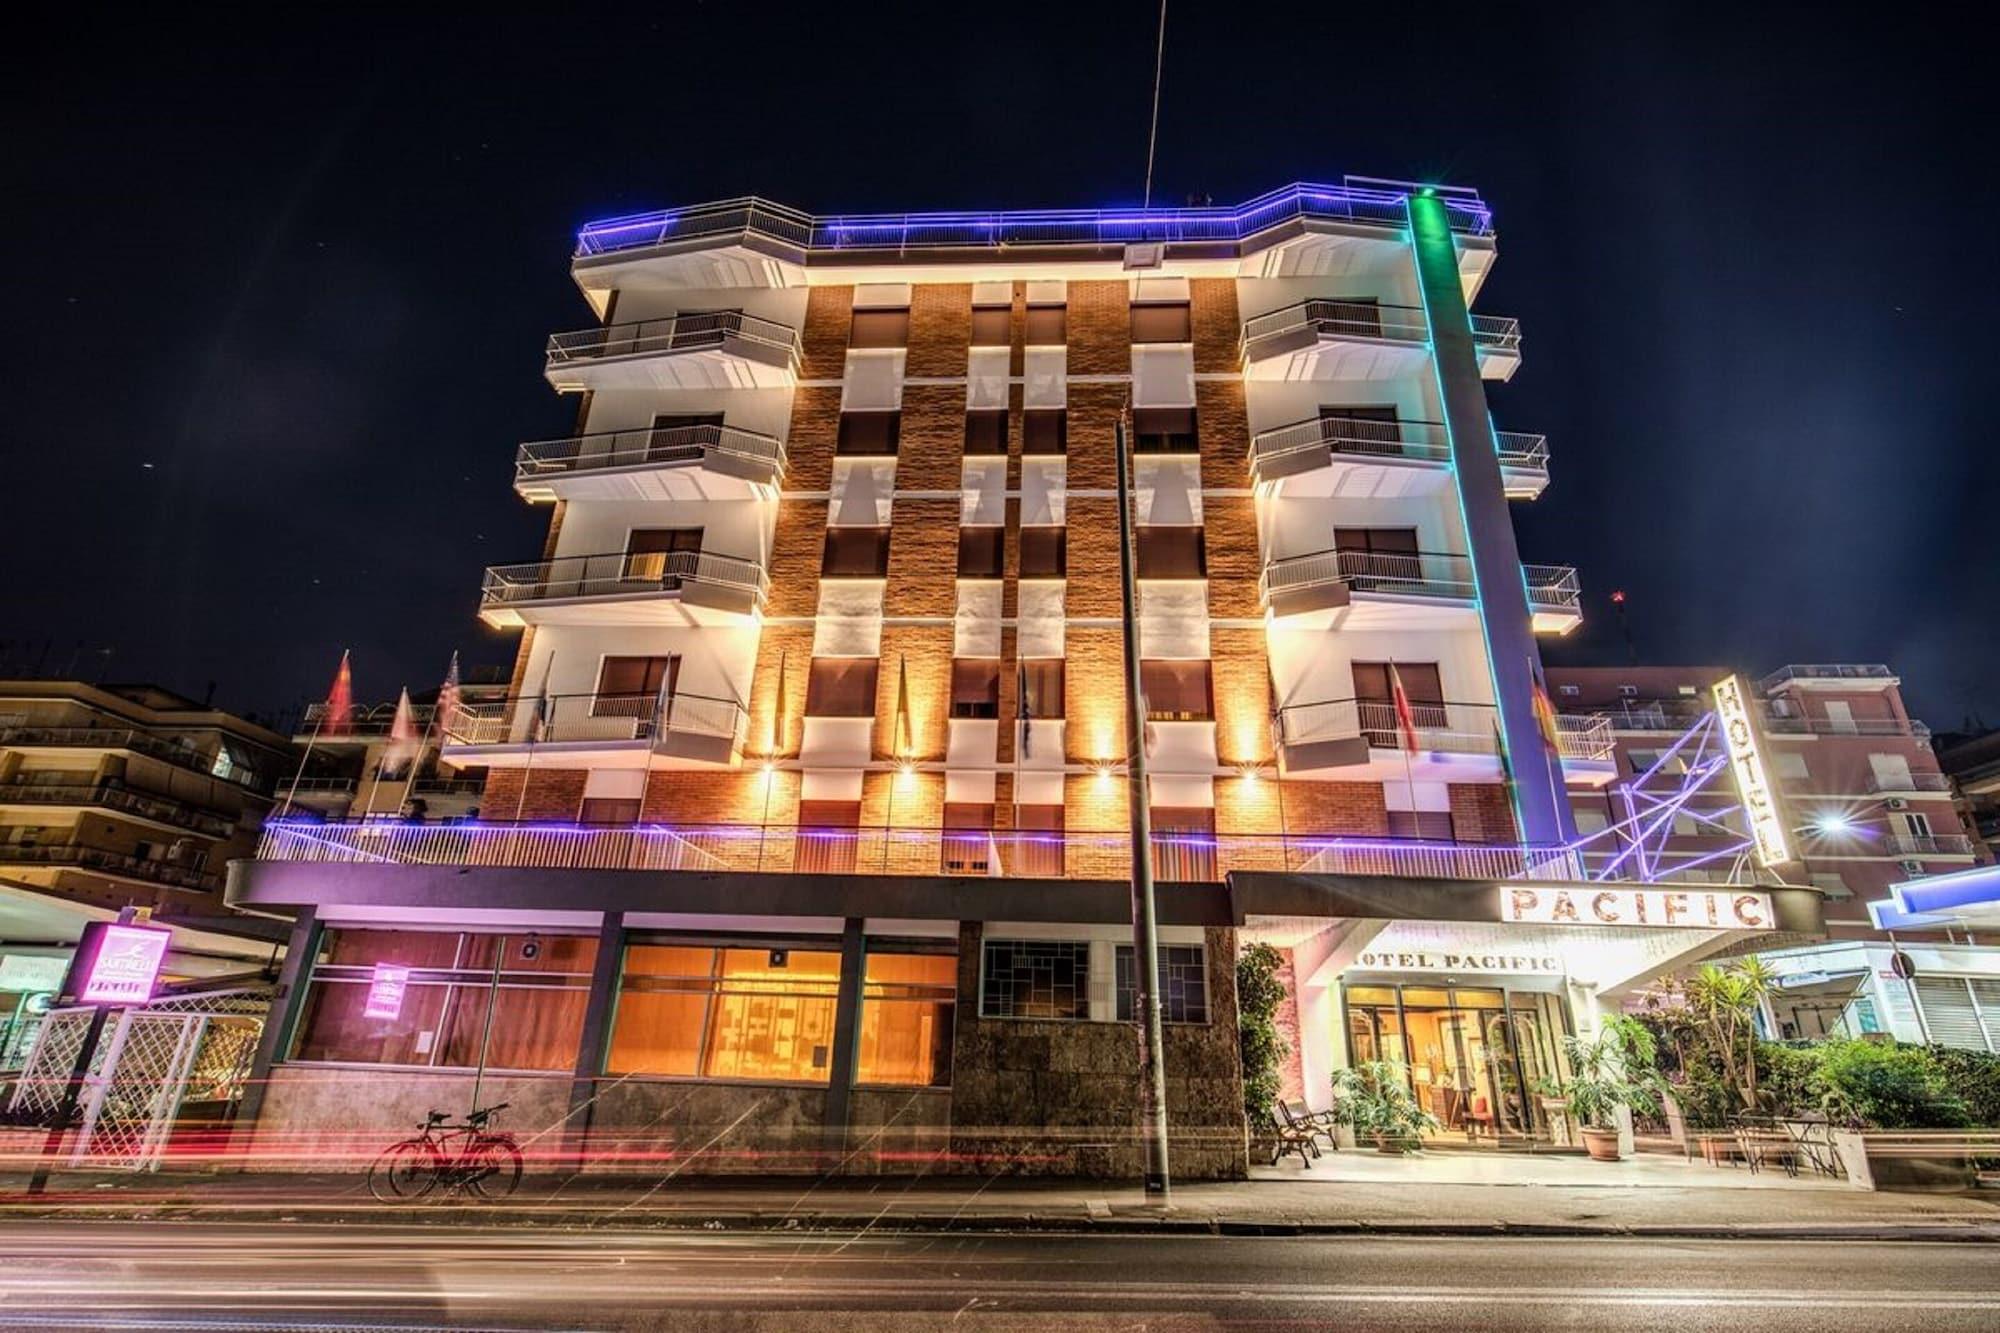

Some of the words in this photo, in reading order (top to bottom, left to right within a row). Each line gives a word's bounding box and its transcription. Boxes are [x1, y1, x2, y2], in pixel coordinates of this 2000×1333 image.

[1717, 682, 1784, 861] HOTEL
[1511, 889, 1762, 927] PACIFIC
[1353, 953, 1434, 968] OTEL
[1442, 954, 1556, 971] PACIFIC
